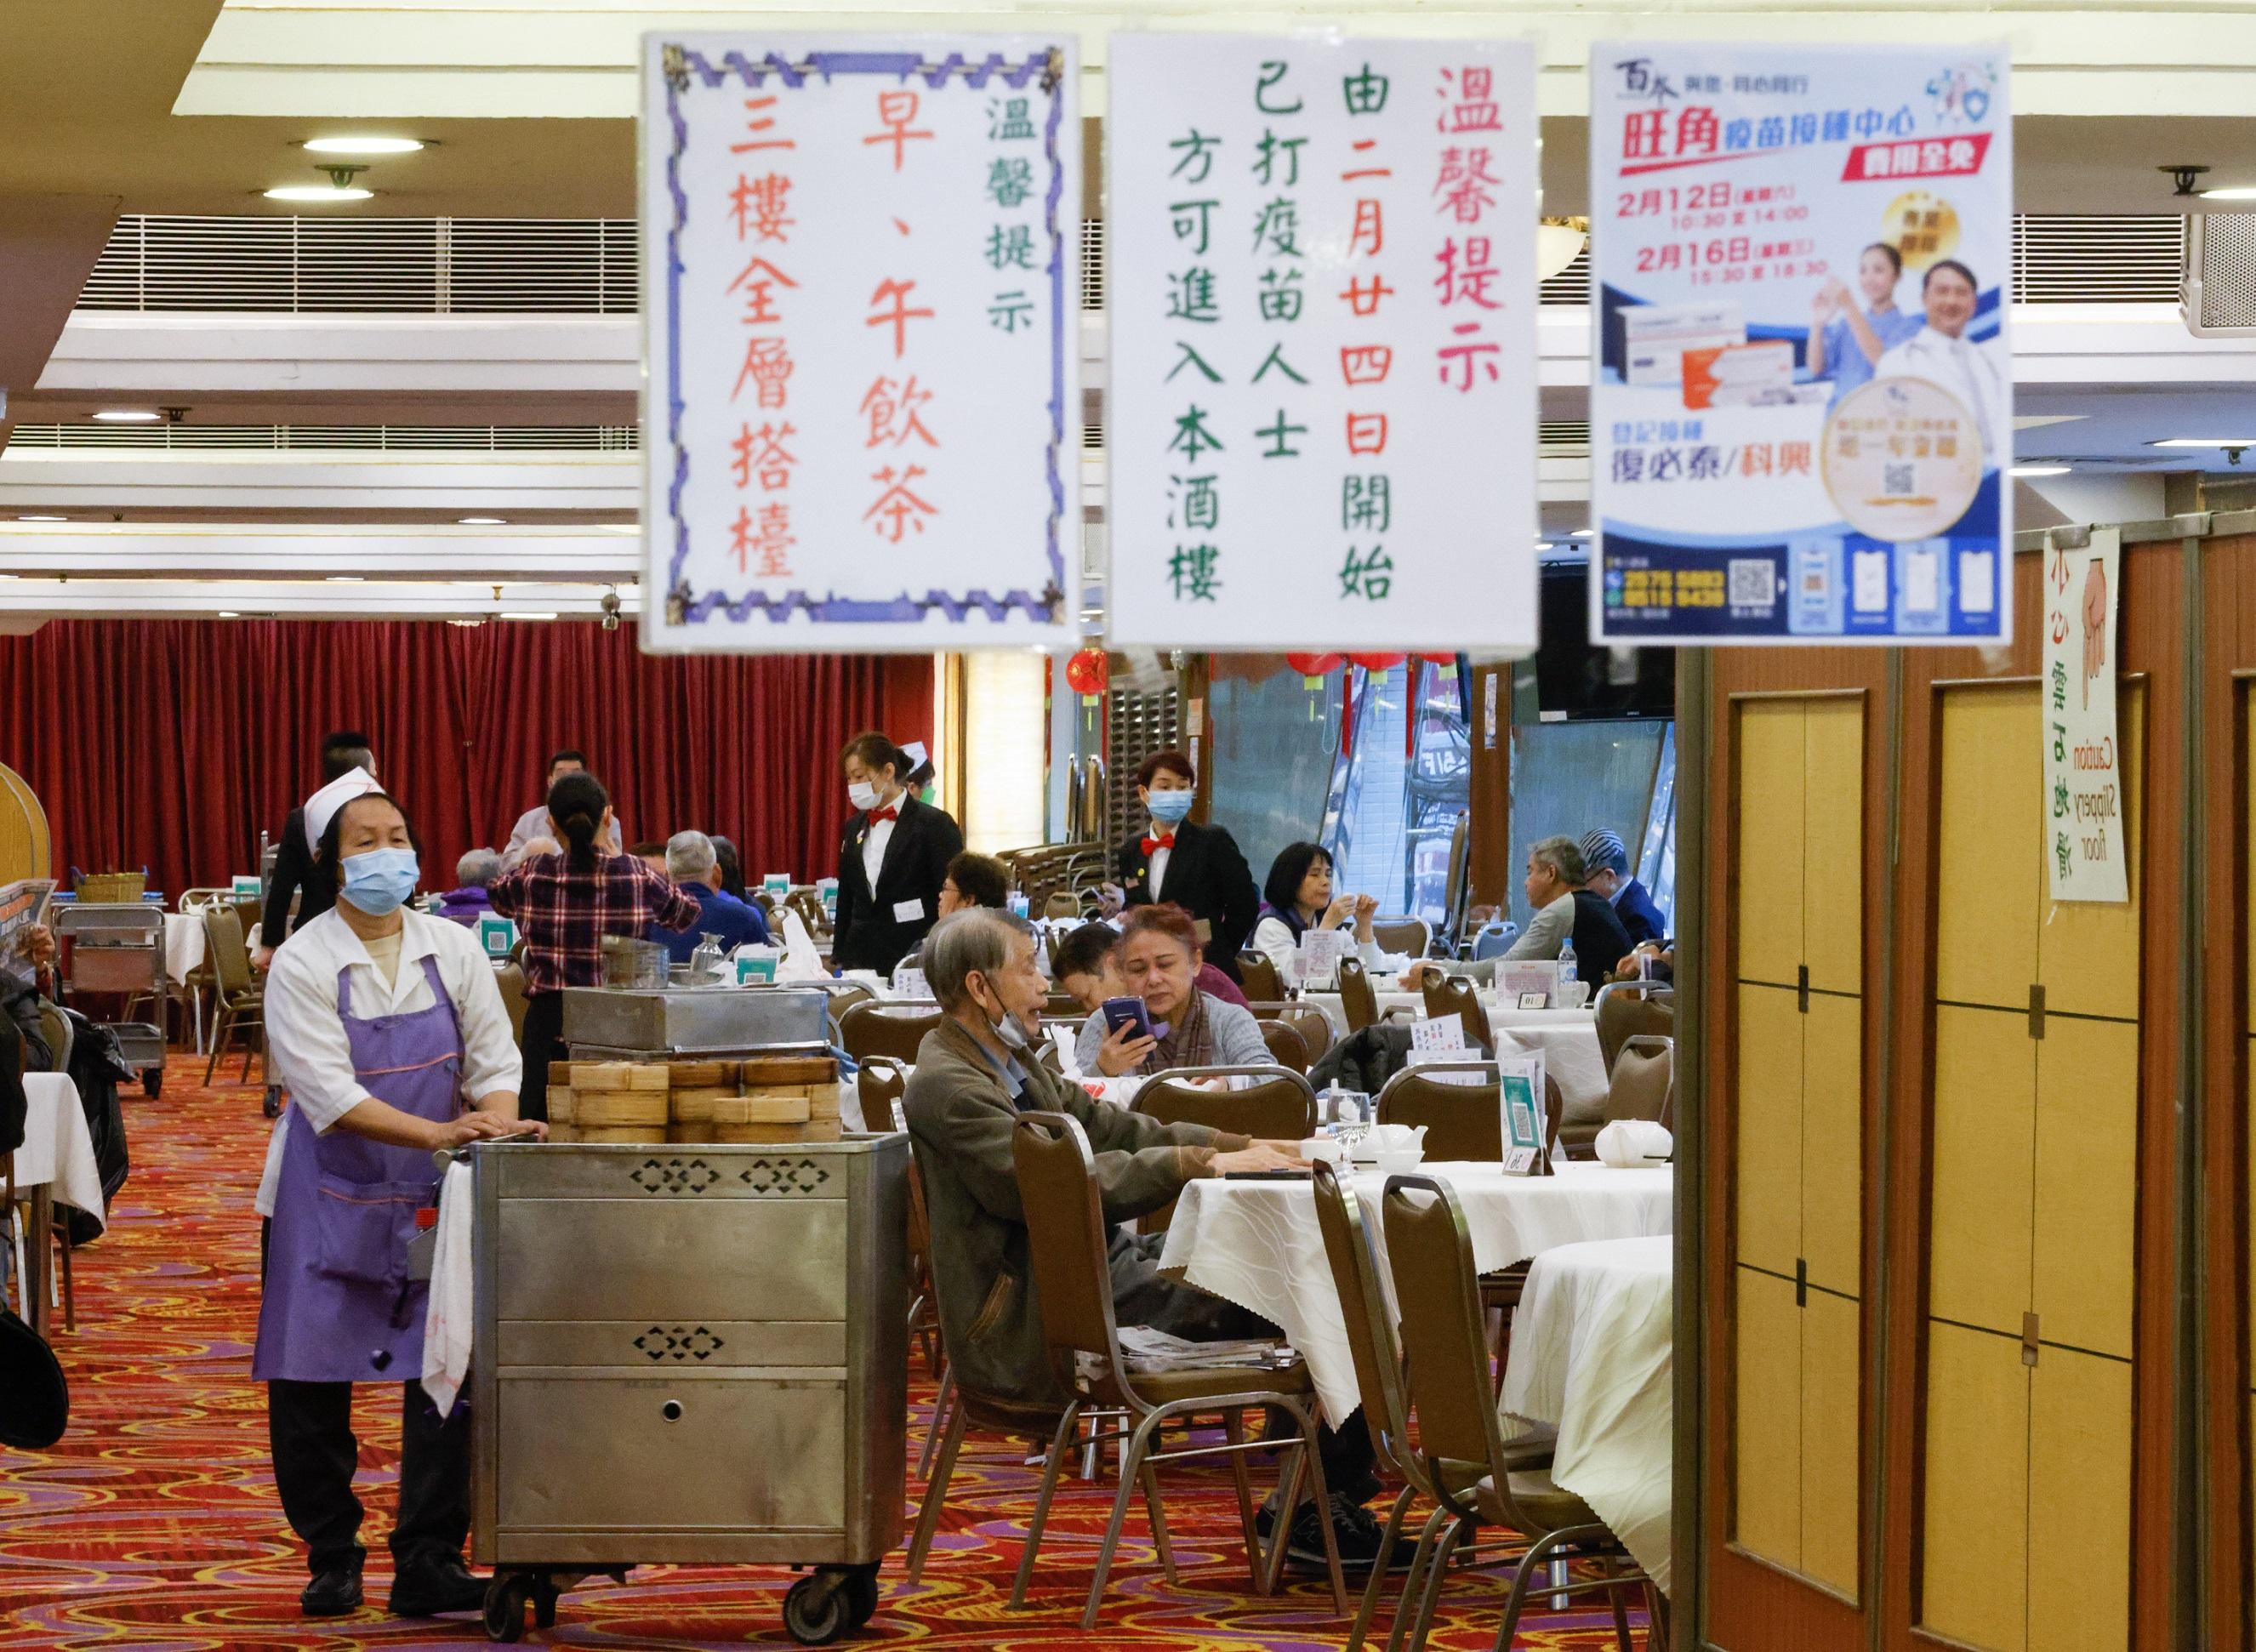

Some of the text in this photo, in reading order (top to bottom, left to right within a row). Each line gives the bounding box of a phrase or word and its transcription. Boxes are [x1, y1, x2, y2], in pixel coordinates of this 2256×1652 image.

[726, 94, 800, 578] 三樓全層搭檯
[858, 89, 939, 545] 早、午飲茶
[984, 96, 1037, 334] 溫馨提示
[1165, 128, 1225, 603] 方可進入本酒樓
[1250, 60, 1310, 459] 已打疫苗人士
[1338, 61, 1395, 602] 由二月廿四日開始
[1433, 66, 1504, 394] 溫馨提示
